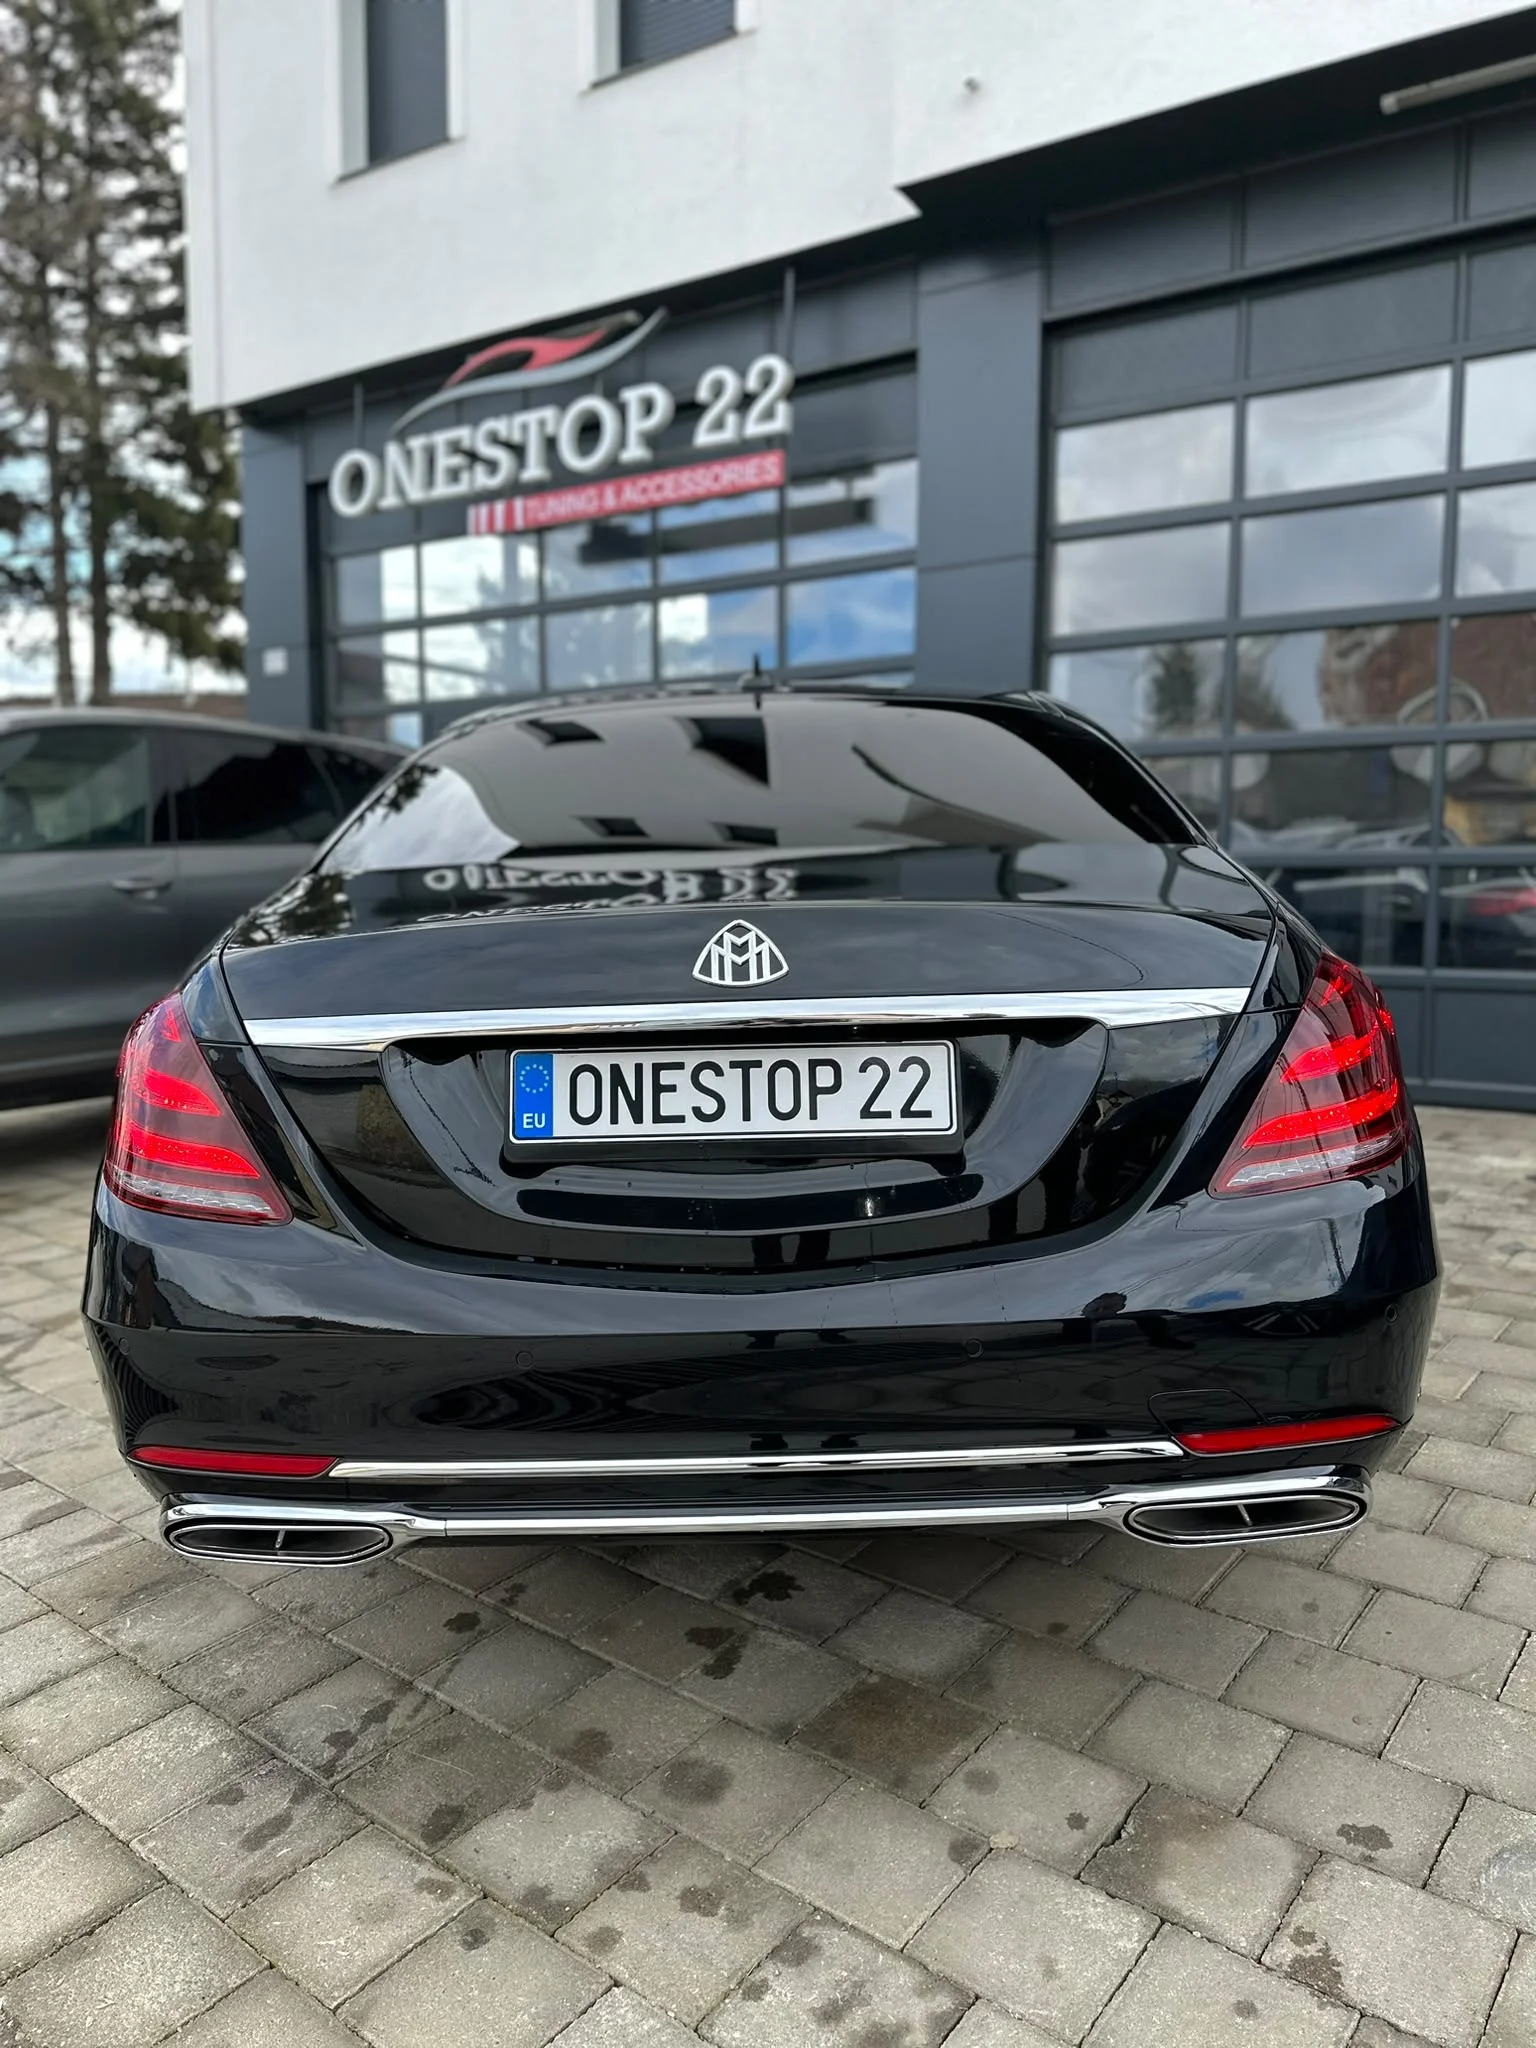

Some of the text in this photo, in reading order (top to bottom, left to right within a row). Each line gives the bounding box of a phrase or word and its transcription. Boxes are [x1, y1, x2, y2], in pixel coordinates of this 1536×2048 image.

[328, 354, 795, 517] ONESTOP 22
[621, 456, 780, 503] ACCESSORIES
[568, 1056, 933, 1126] ONESTOP 22
[522, 1112, 547, 1129] EU
